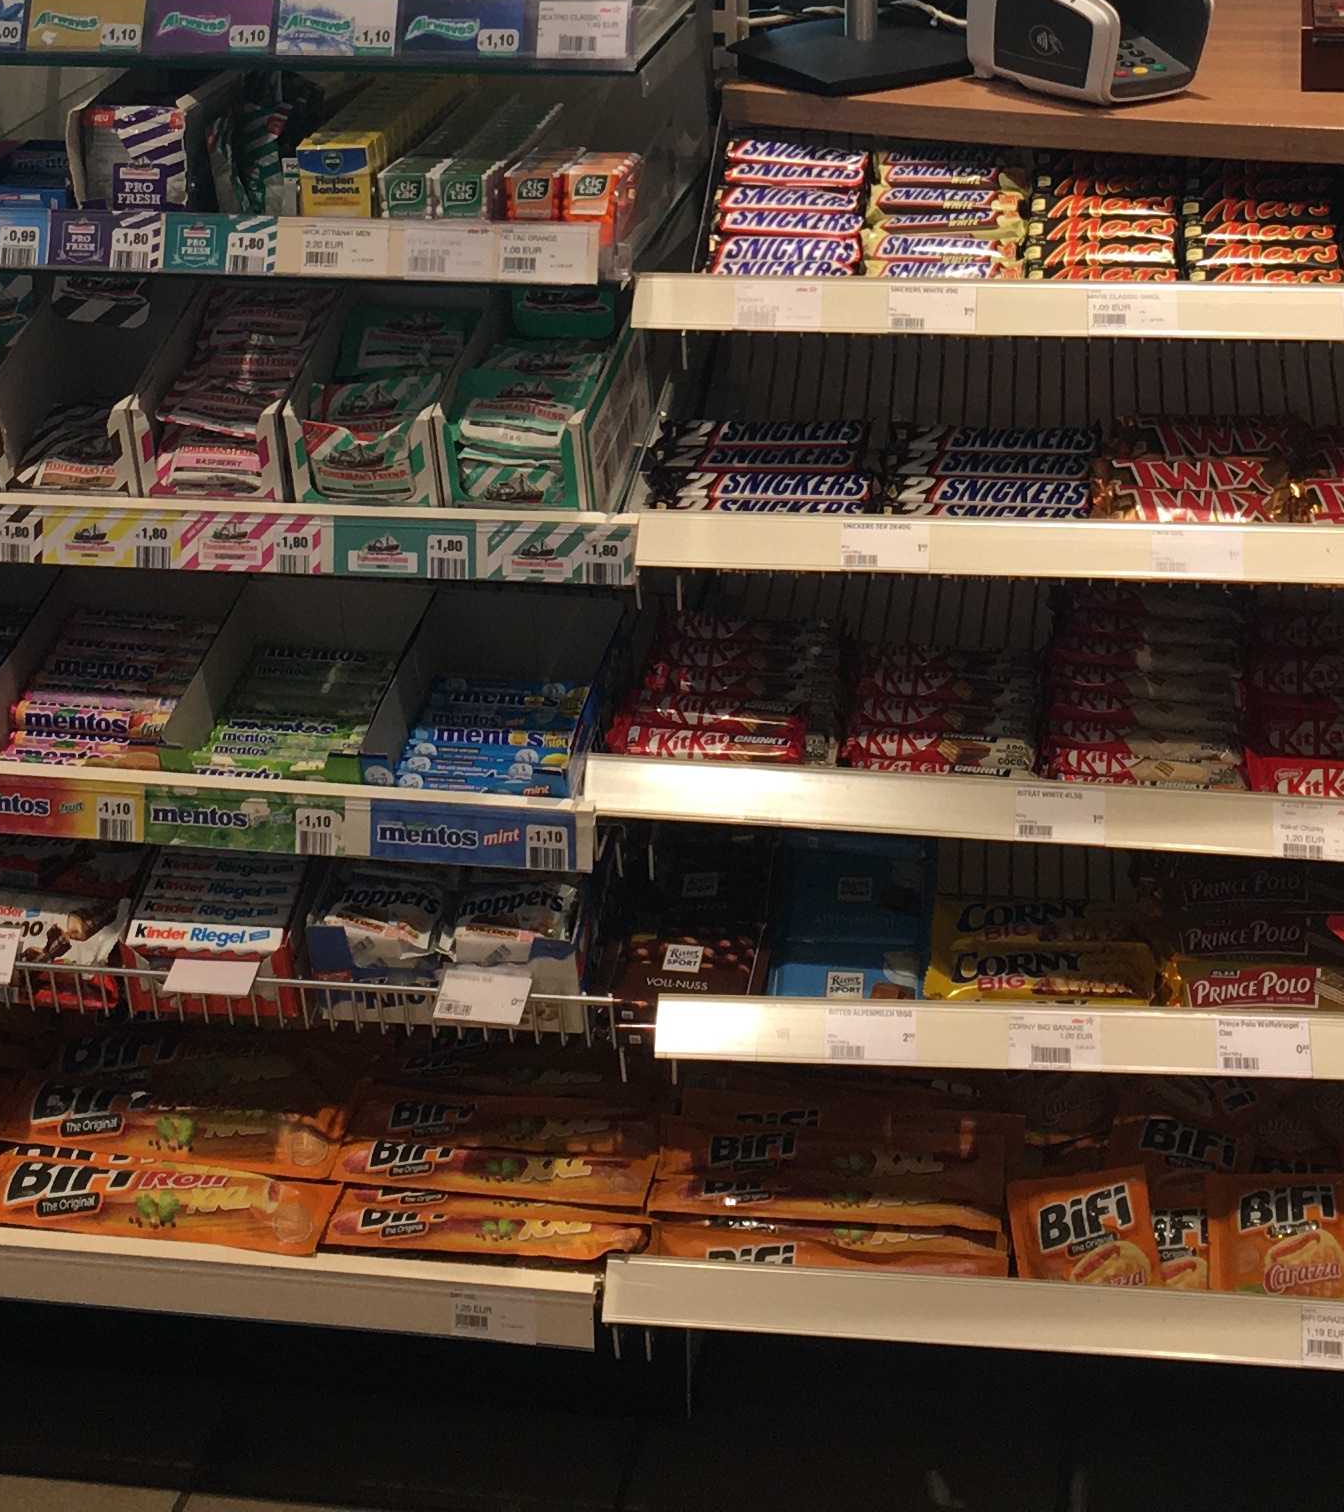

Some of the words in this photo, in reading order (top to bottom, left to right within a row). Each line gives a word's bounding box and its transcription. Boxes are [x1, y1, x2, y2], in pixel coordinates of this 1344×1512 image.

[236, 28, 265, 43] 1,10
[91, 112, 109, 123] NEU
[123, 181, 159, 196] PRO
[117, 192, 161, 207] FRESH
[1048, 195, 1175, 218] Mars
[121, 230, 149, 246] 1,80
[725, 238, 856, 261] SNICKERS
[1114, 460, 1273, 489] TWIX
[944, 480, 1085, 504] SNICKERS
[652, 729, 730, 756] KitKat
[734, 733, 786, 747] CHUNKY
[153, 806, 248, 828] mentos
[378, 824, 478, 847] mentos
[483, 828, 520, 846] mint
[190, 928, 248, 946] Riegel
[666, 958, 700, 970] SPORT
[951, 953, 1082, 983] CORNY
[646, 977, 709, 991] VOLL-NUSS
[977, 974, 1027, 992] BIG
[1194, 975, 1258, 1007] PRINCE
[1260, 975, 1312, 999] POLO
